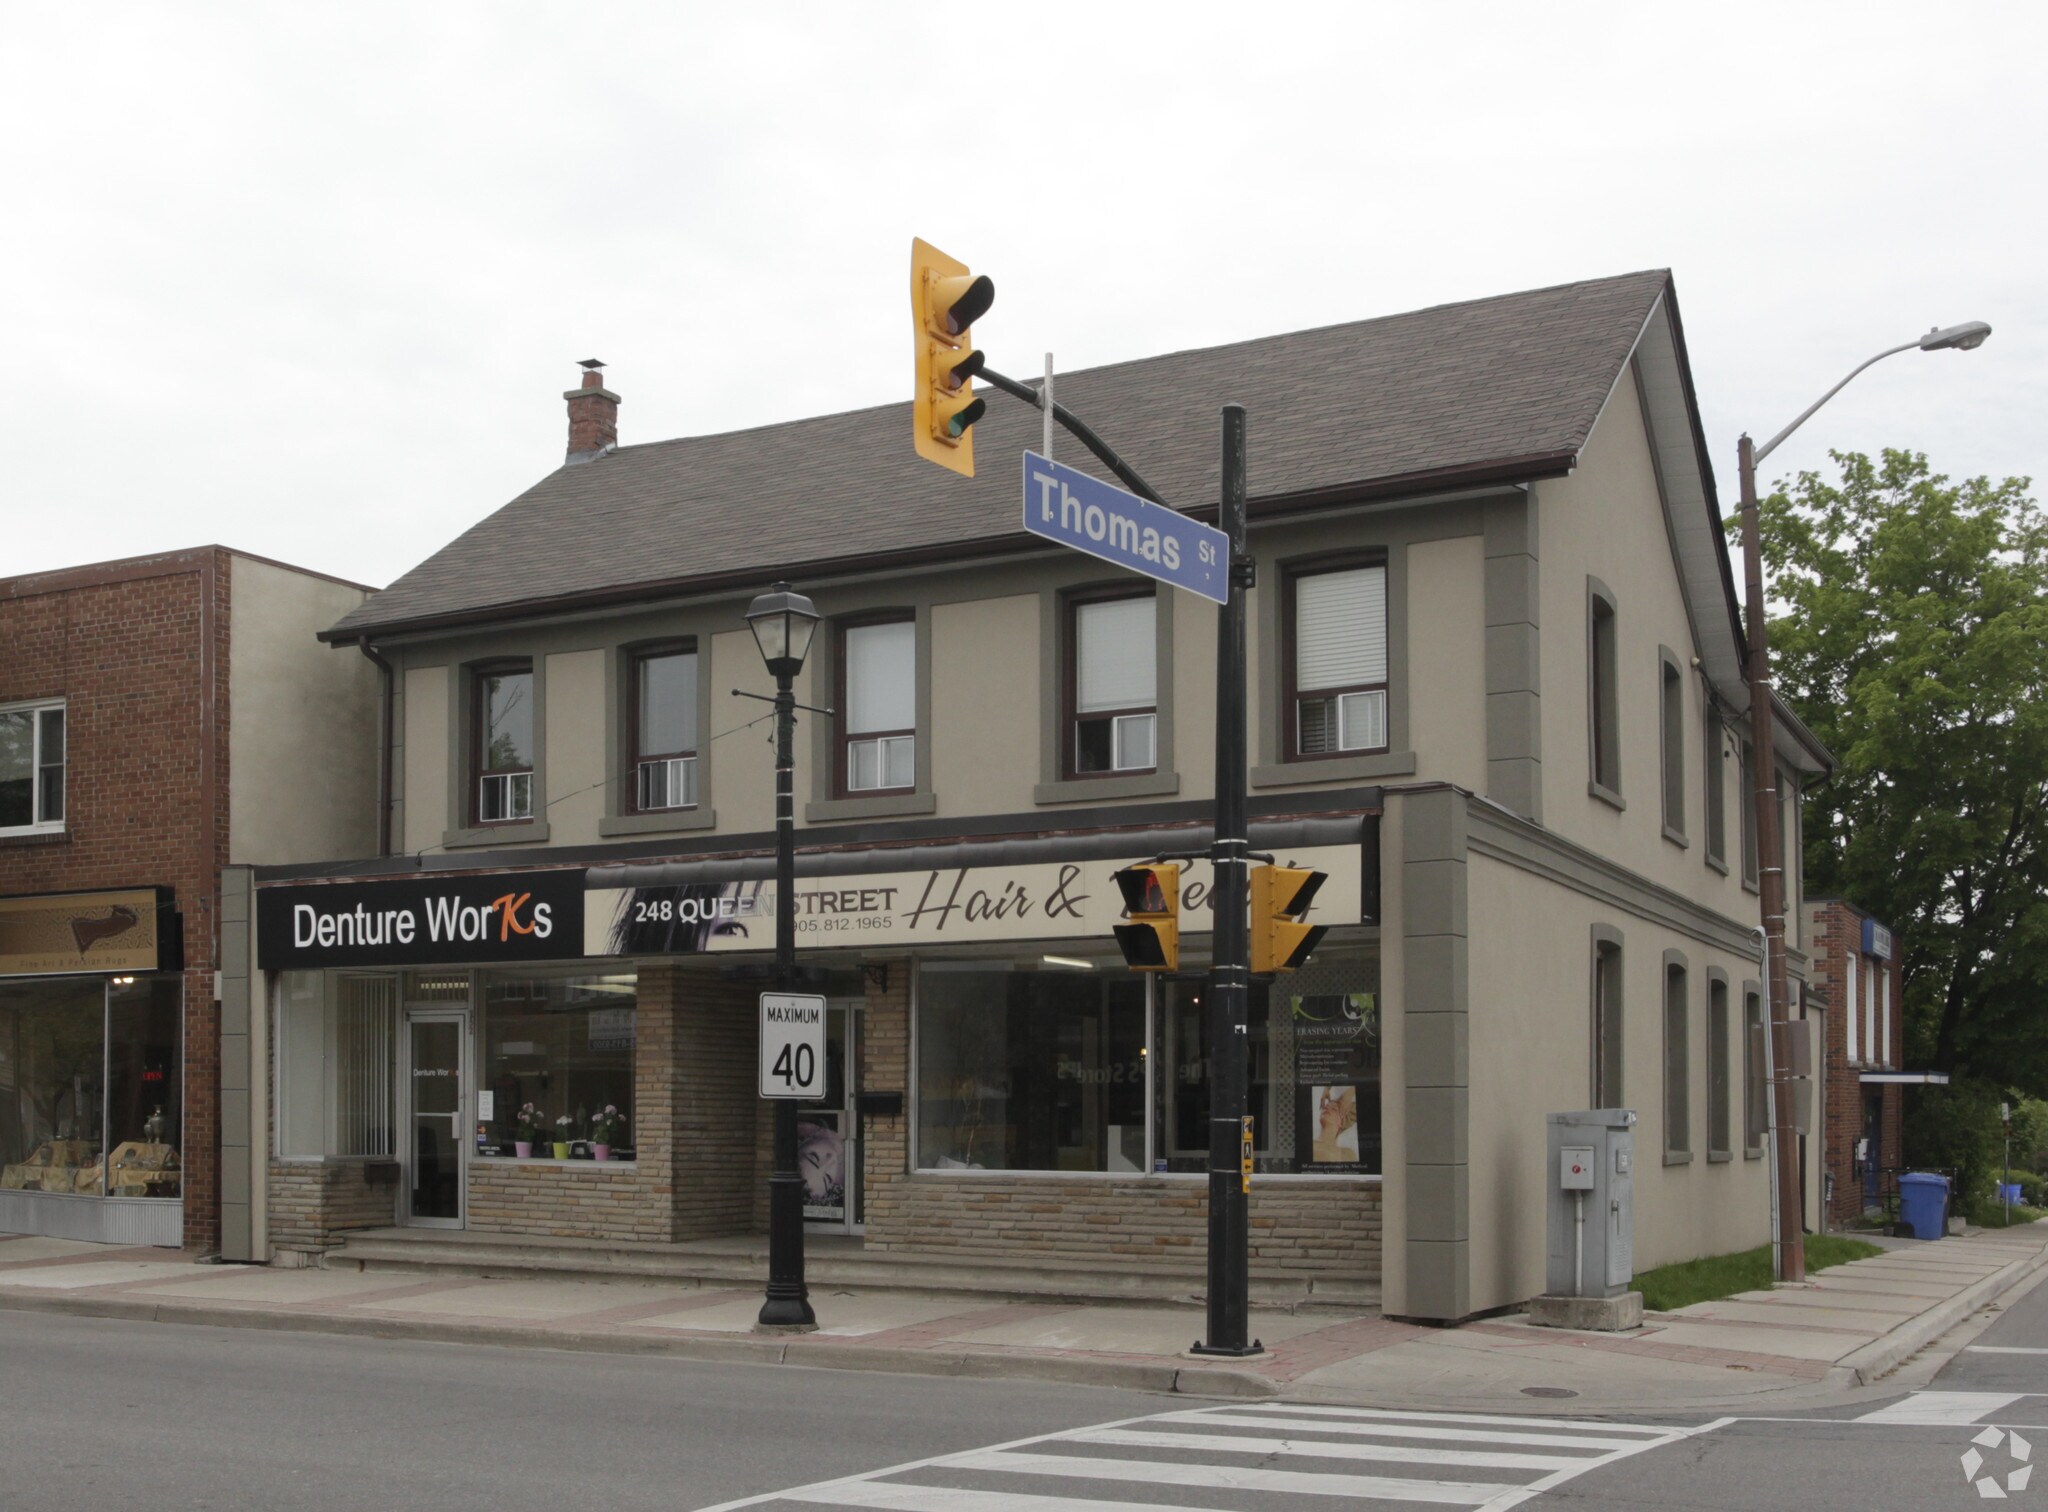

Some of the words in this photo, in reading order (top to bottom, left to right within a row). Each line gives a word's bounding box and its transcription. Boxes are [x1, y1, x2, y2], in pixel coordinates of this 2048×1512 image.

[1033, 471, 1181, 570] Thomas
[1198, 539, 1216, 567] St
[635, 900, 673, 922] 248
[679, 893, 776, 925] QUEEN
[901, 867, 1036, 931] Hair
[1044, 864, 1092, 919] &
[294, 902, 416, 948] Denture
[106, 957, 127, 965] Rugs
[767, 1007, 819, 1024] MAXIMUM
[413, 1068, 436, 1077] Denture
[772, 1043, 815, 1088] 40
